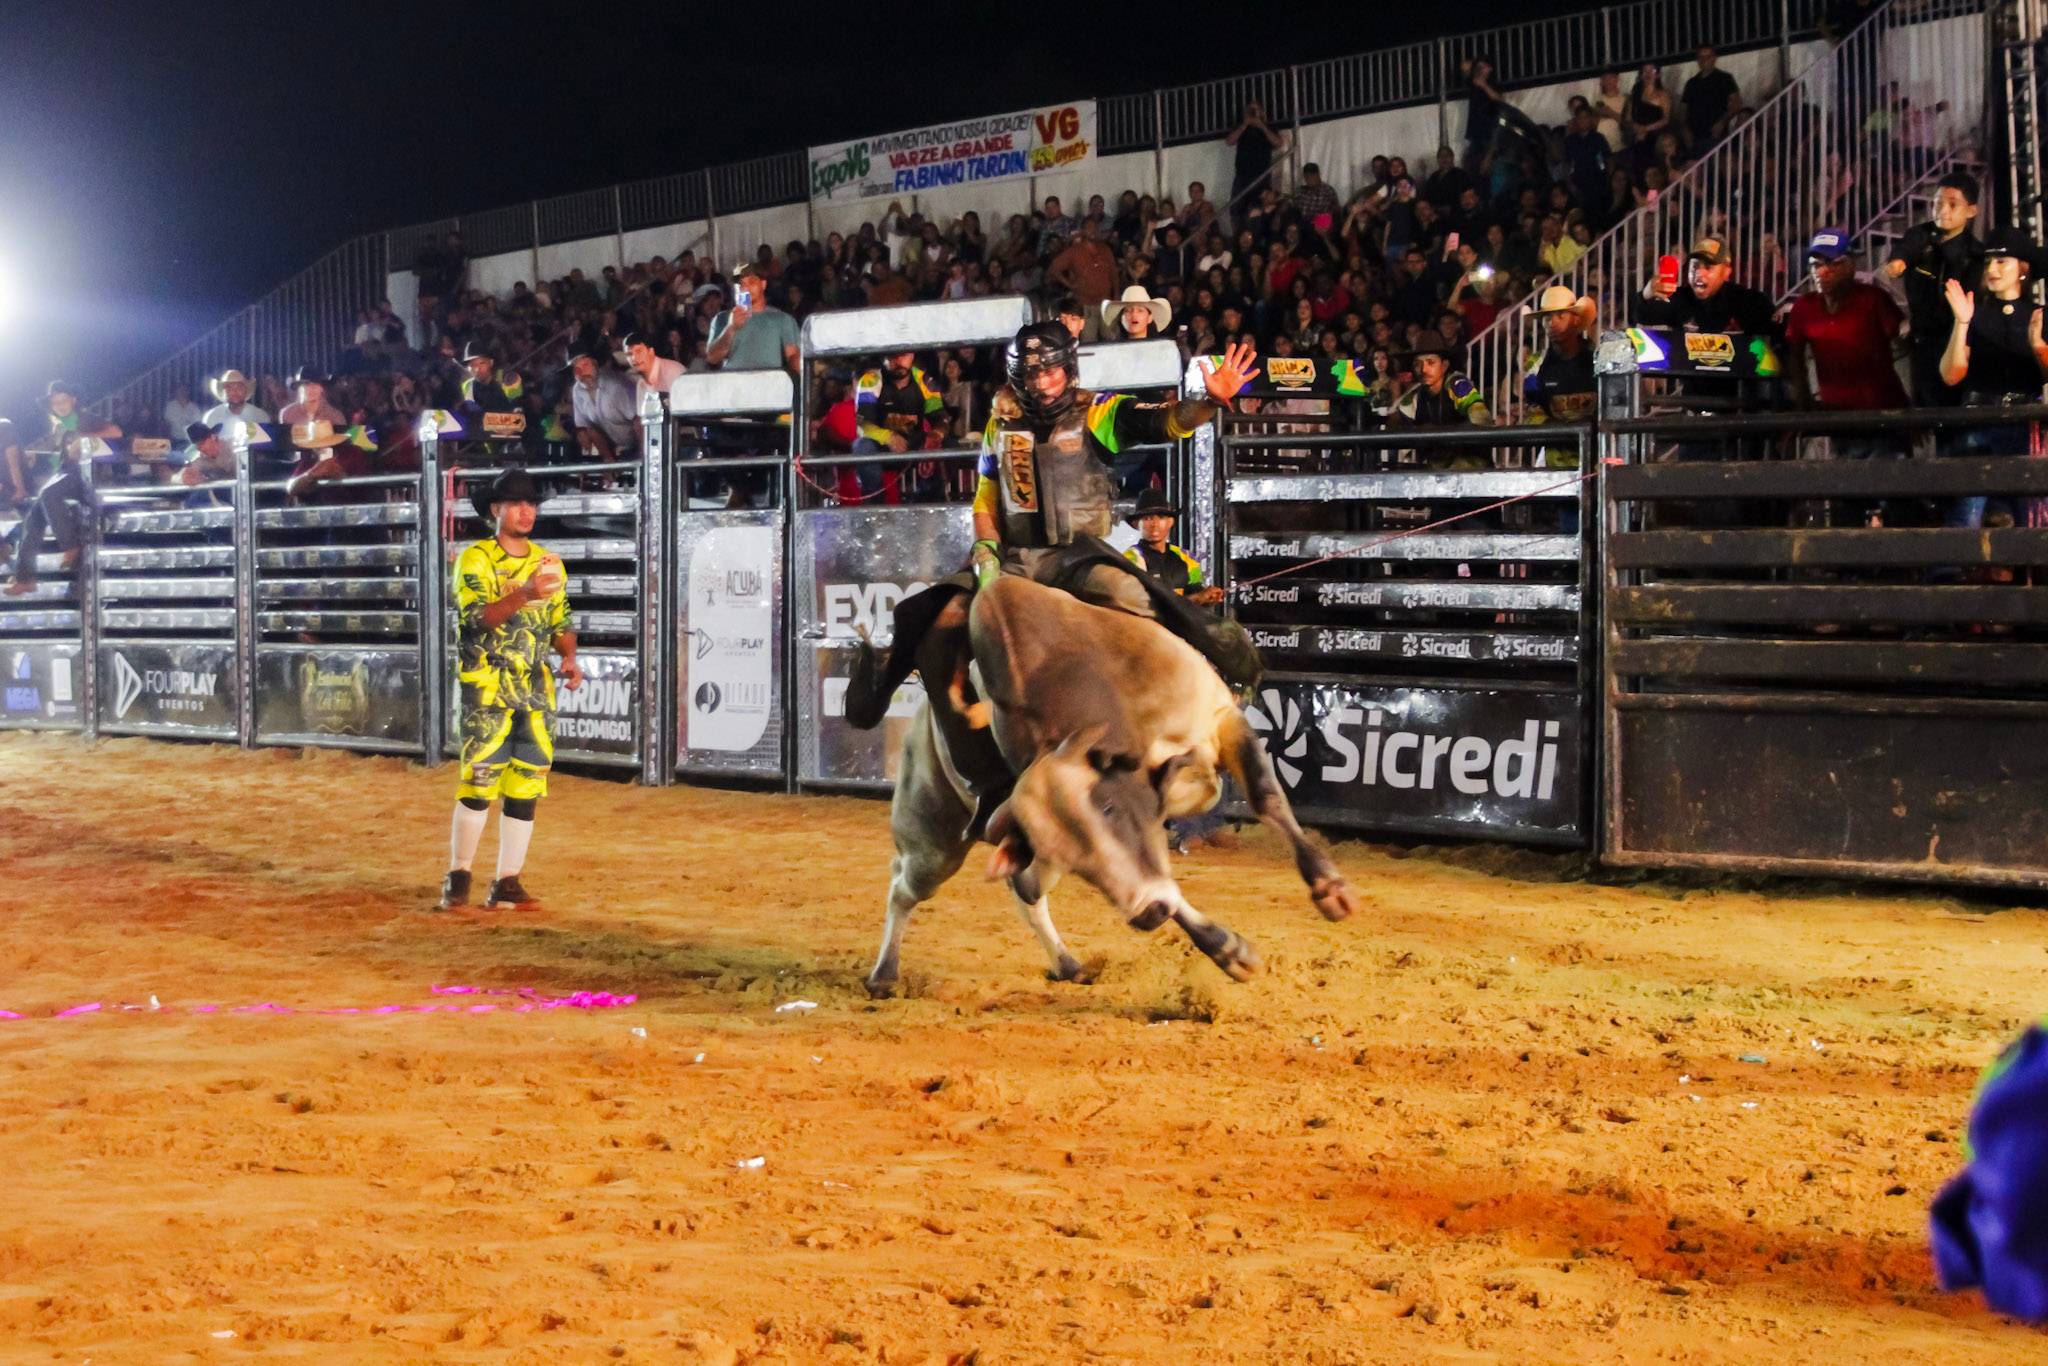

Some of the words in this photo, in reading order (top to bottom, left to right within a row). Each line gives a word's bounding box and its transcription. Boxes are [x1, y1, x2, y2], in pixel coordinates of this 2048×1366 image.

[871, 126, 953, 155] MOVIMENTANDO
[954, 120, 987, 140] NOSSA
[1035, 107, 1080, 145] VG
[953, 133, 1013, 160] GRANDE
[895, 159, 965, 193] FABINHO
[968, 149, 1027, 181] TARDIN
[1336, 481, 1383, 499] Sicredi
[1256, 538, 1300, 557] Sicredi
[1256, 586, 1299, 603] Sicredi
[1335, 583, 1382, 605] Sicredi
[1421, 589, 1469, 606] Sicredi
[1255, 631, 1299, 648] Sicredi
[1335, 631, 1382, 651] Sicredi
[1421, 637, 1470, 657] Sicredi
[1513, 638, 1565, 657] Sicredi
[145, 671, 218, 696] FOURPLAY
[158, 698, 204, 712] EVENTOS
[577, 718, 632, 742] COMIGO!
[1322, 707, 1560, 800] Sicredi
